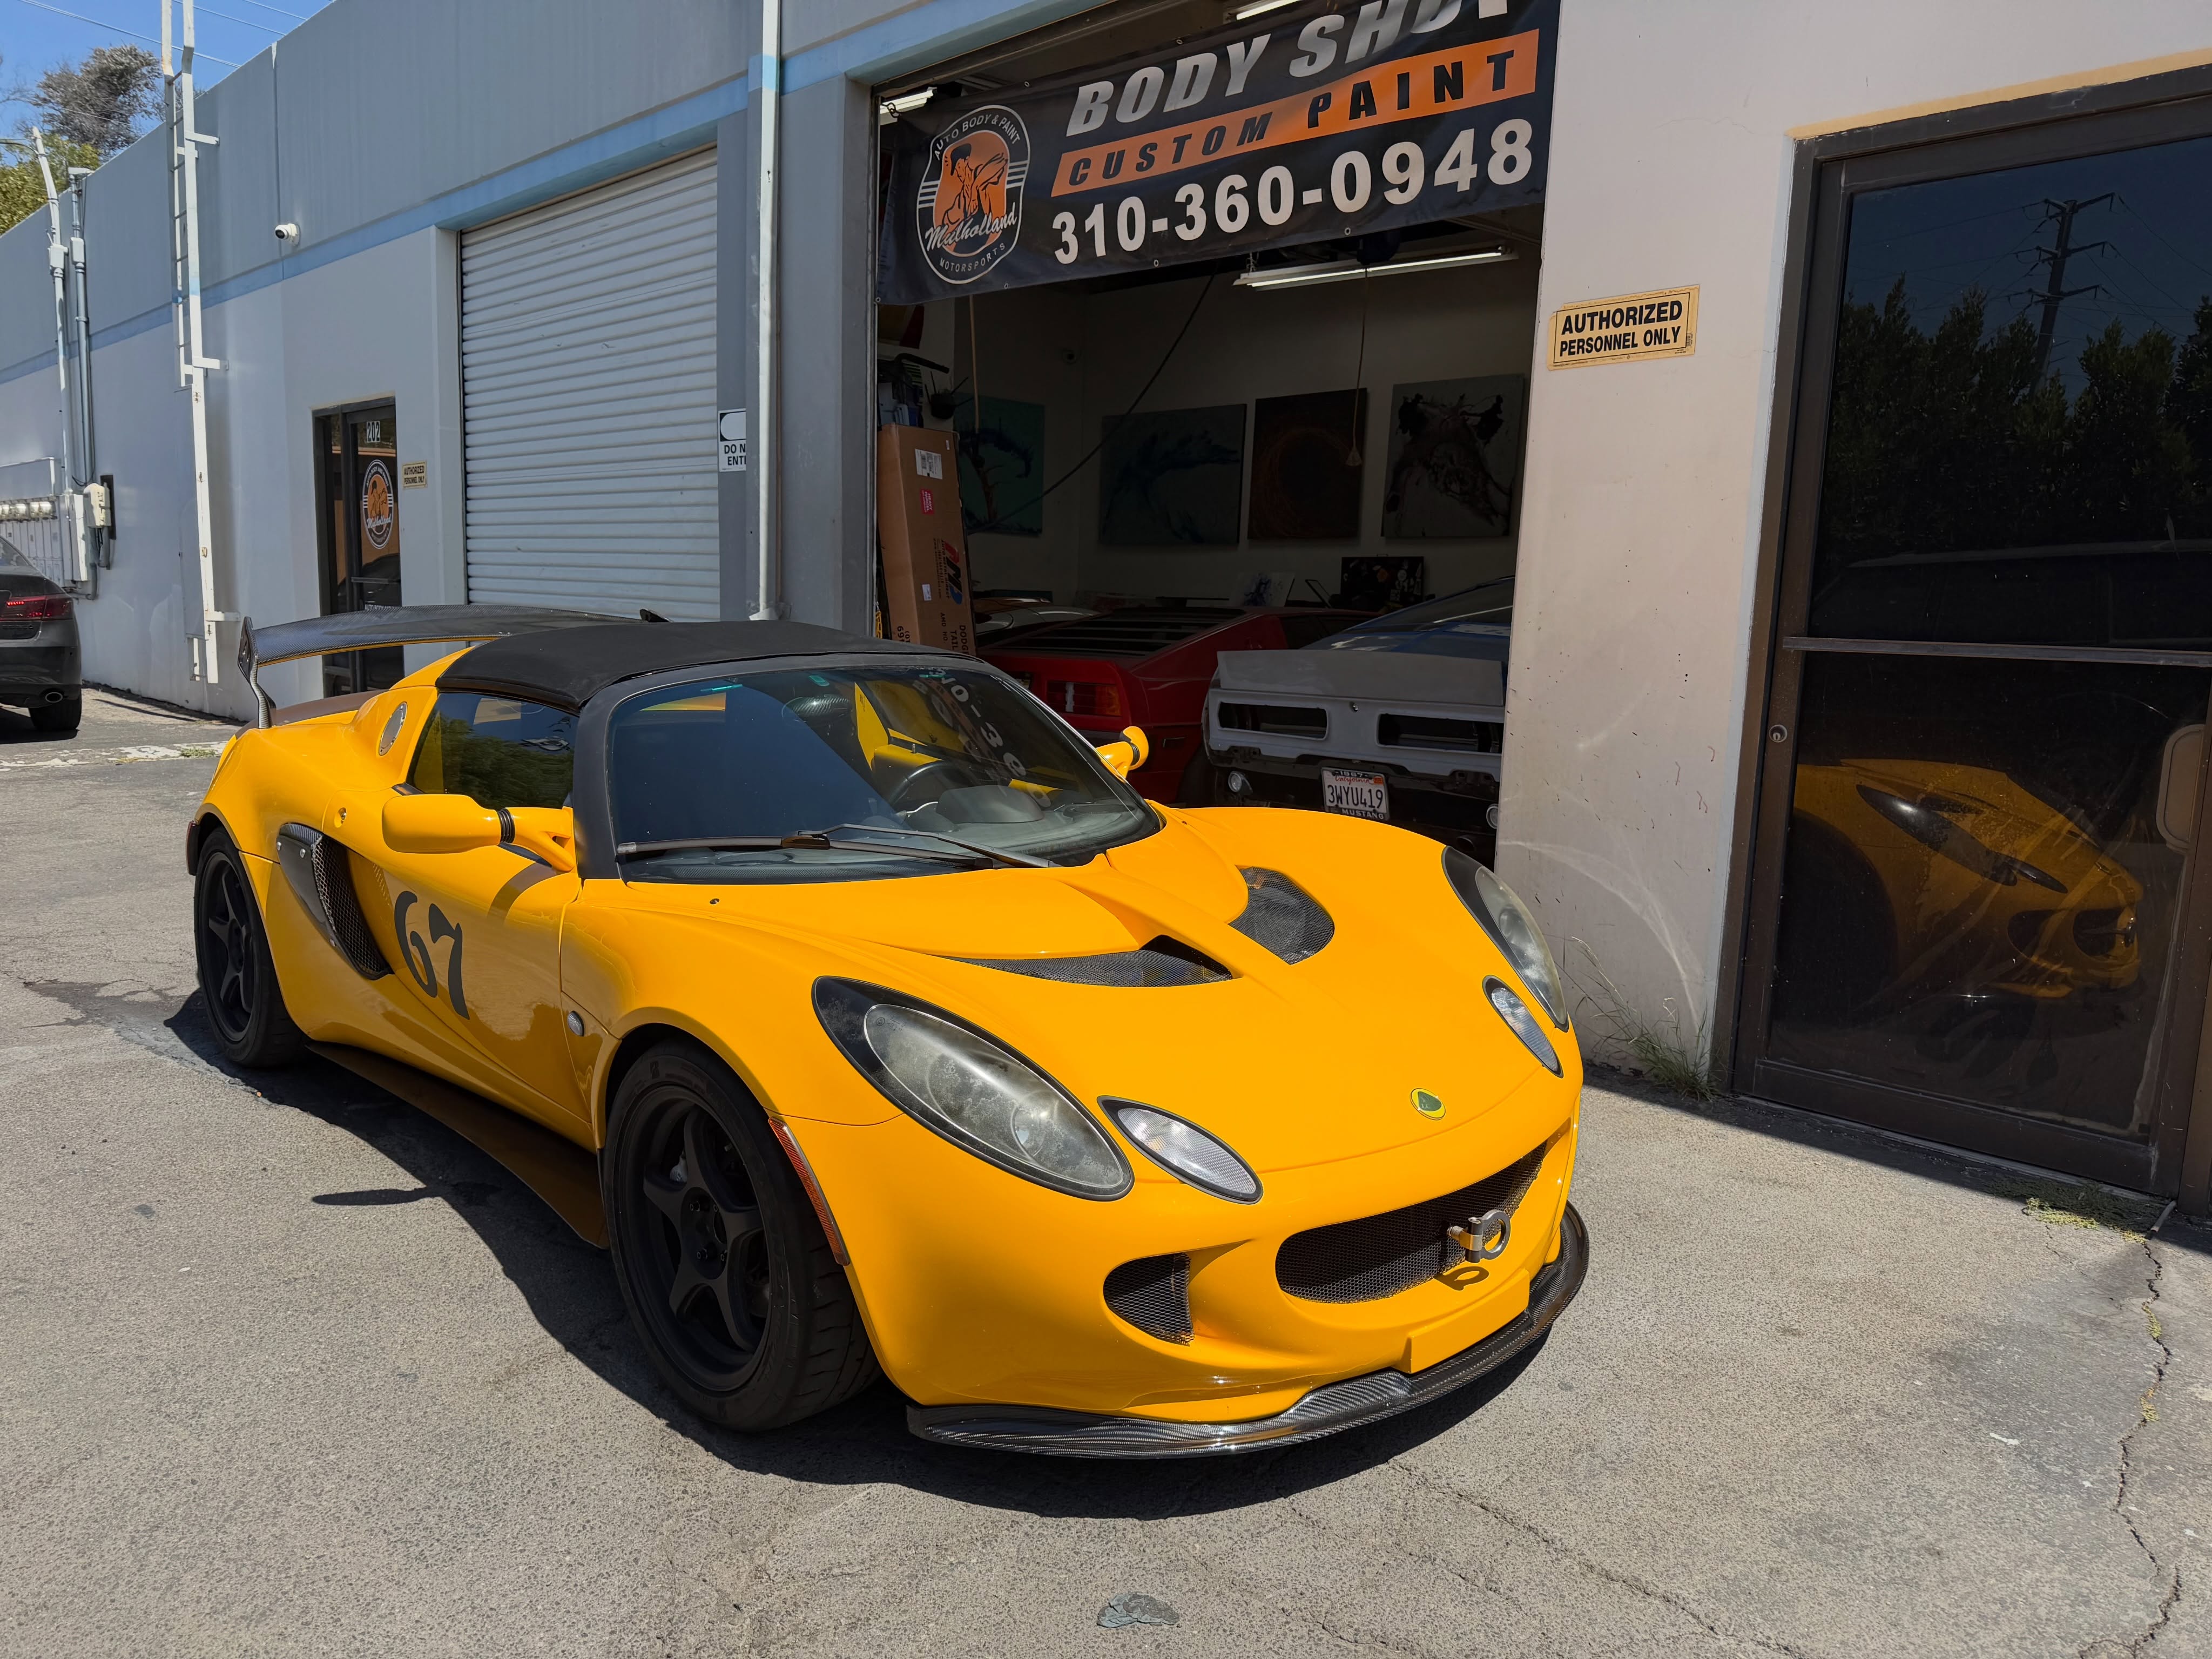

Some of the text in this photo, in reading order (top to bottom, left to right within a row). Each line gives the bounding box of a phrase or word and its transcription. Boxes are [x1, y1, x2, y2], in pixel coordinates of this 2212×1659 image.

[1066, 33, 1271, 137] BODY
[1069, 50, 1514, 186] CUSTOM PAINT
[934, 114, 1020, 160] AUTO BODY & PAINT
[1052, 118, 1532, 265] 310-360-0948
[925, 201, 1017, 252] Mulholland
[940, 242, 1006, 273] MOTORSPORTS
[1561, 300, 1683, 335] AUTHORIZED
[1560, 331, 1638, 357] PERSONNEL
[1643, 326, 1681, 347] ONLY
[367, 421, 380, 442] 202
[724, 444, 737, 454] DO
[727, 455, 746, 466] ENT
[950, 629, 959, 650] TAIL
[1327, 785, 1384, 809] 3WYU419
[1341, 808, 1384, 820] MUSTANG
[394, 890, 470, 1020] 67
